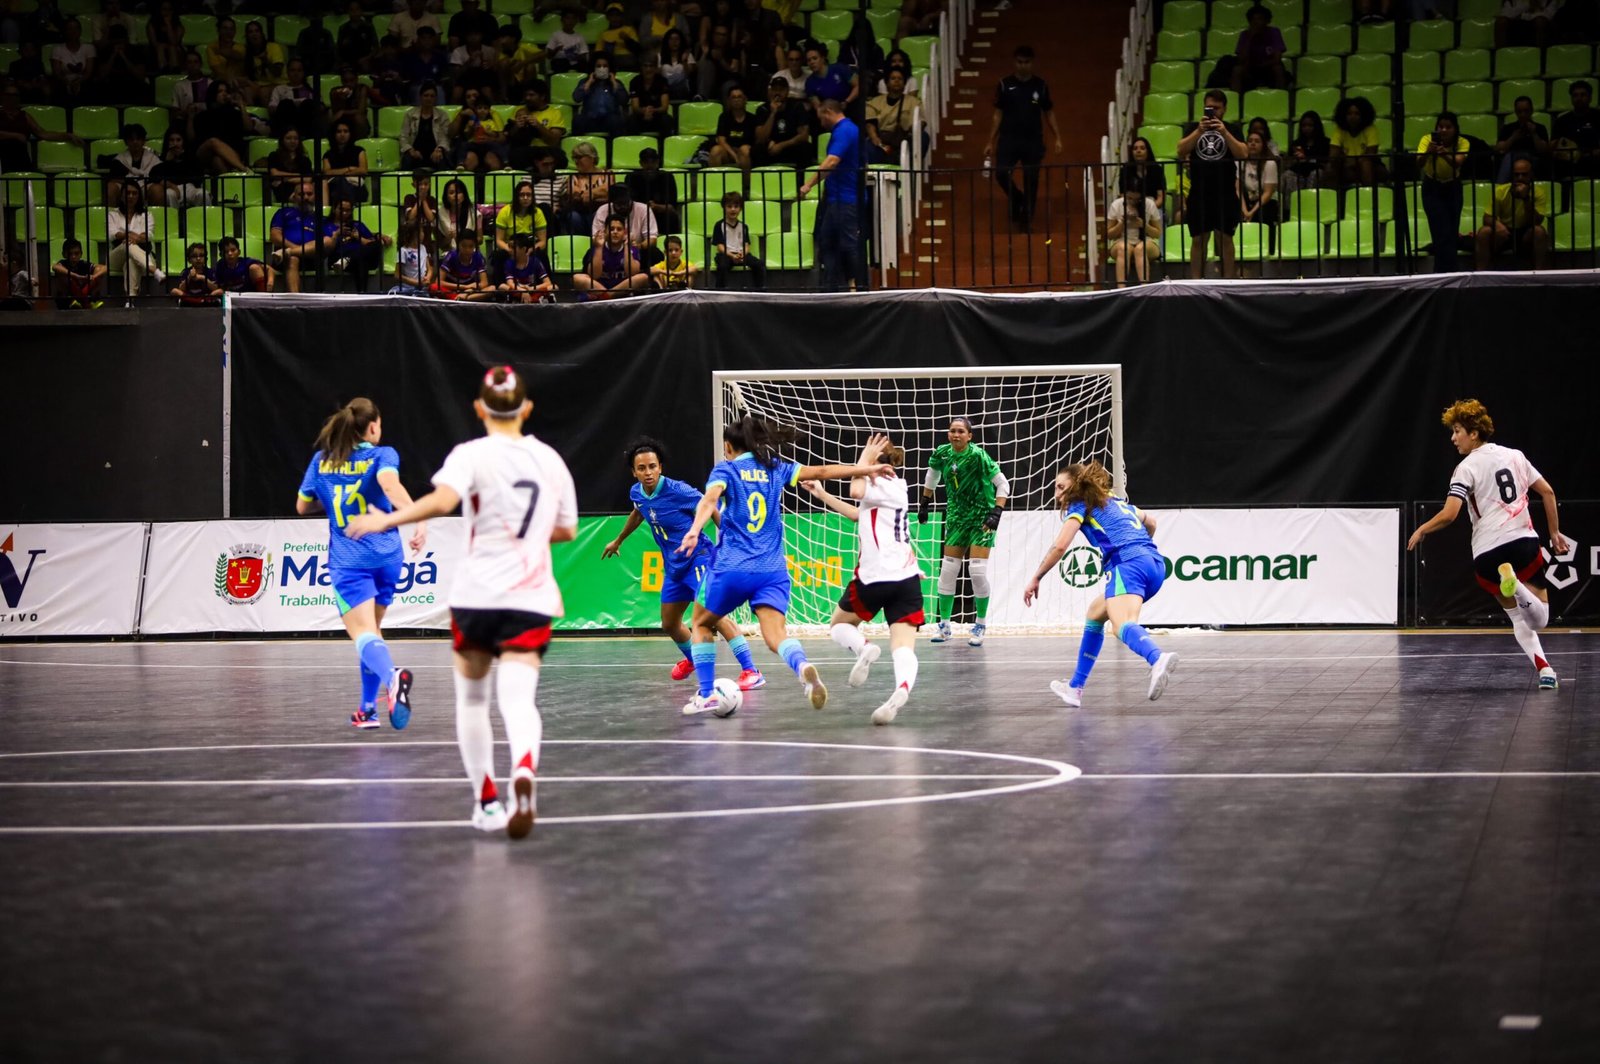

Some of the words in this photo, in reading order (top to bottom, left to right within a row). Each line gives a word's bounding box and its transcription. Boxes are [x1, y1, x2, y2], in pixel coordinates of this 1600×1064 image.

[741, 469, 769, 483] ALICE
[953, 476, 959, 489] 1
[1495, 468, 1517, 504] 8
[333, 479, 367, 527] 13
[512, 480, 540, 539] 7
[747, 491, 767, 533] 9
[1114, 500, 1142, 530] 5
[283, 542, 329, 552] Prefeitu
[653, 525, 669, 541] 11
[280, 552, 437, 593] Magá
[1164, 554, 1317, 581] camar
[279, 594, 337, 606] Trabalha
[401, 592, 435, 604] você
